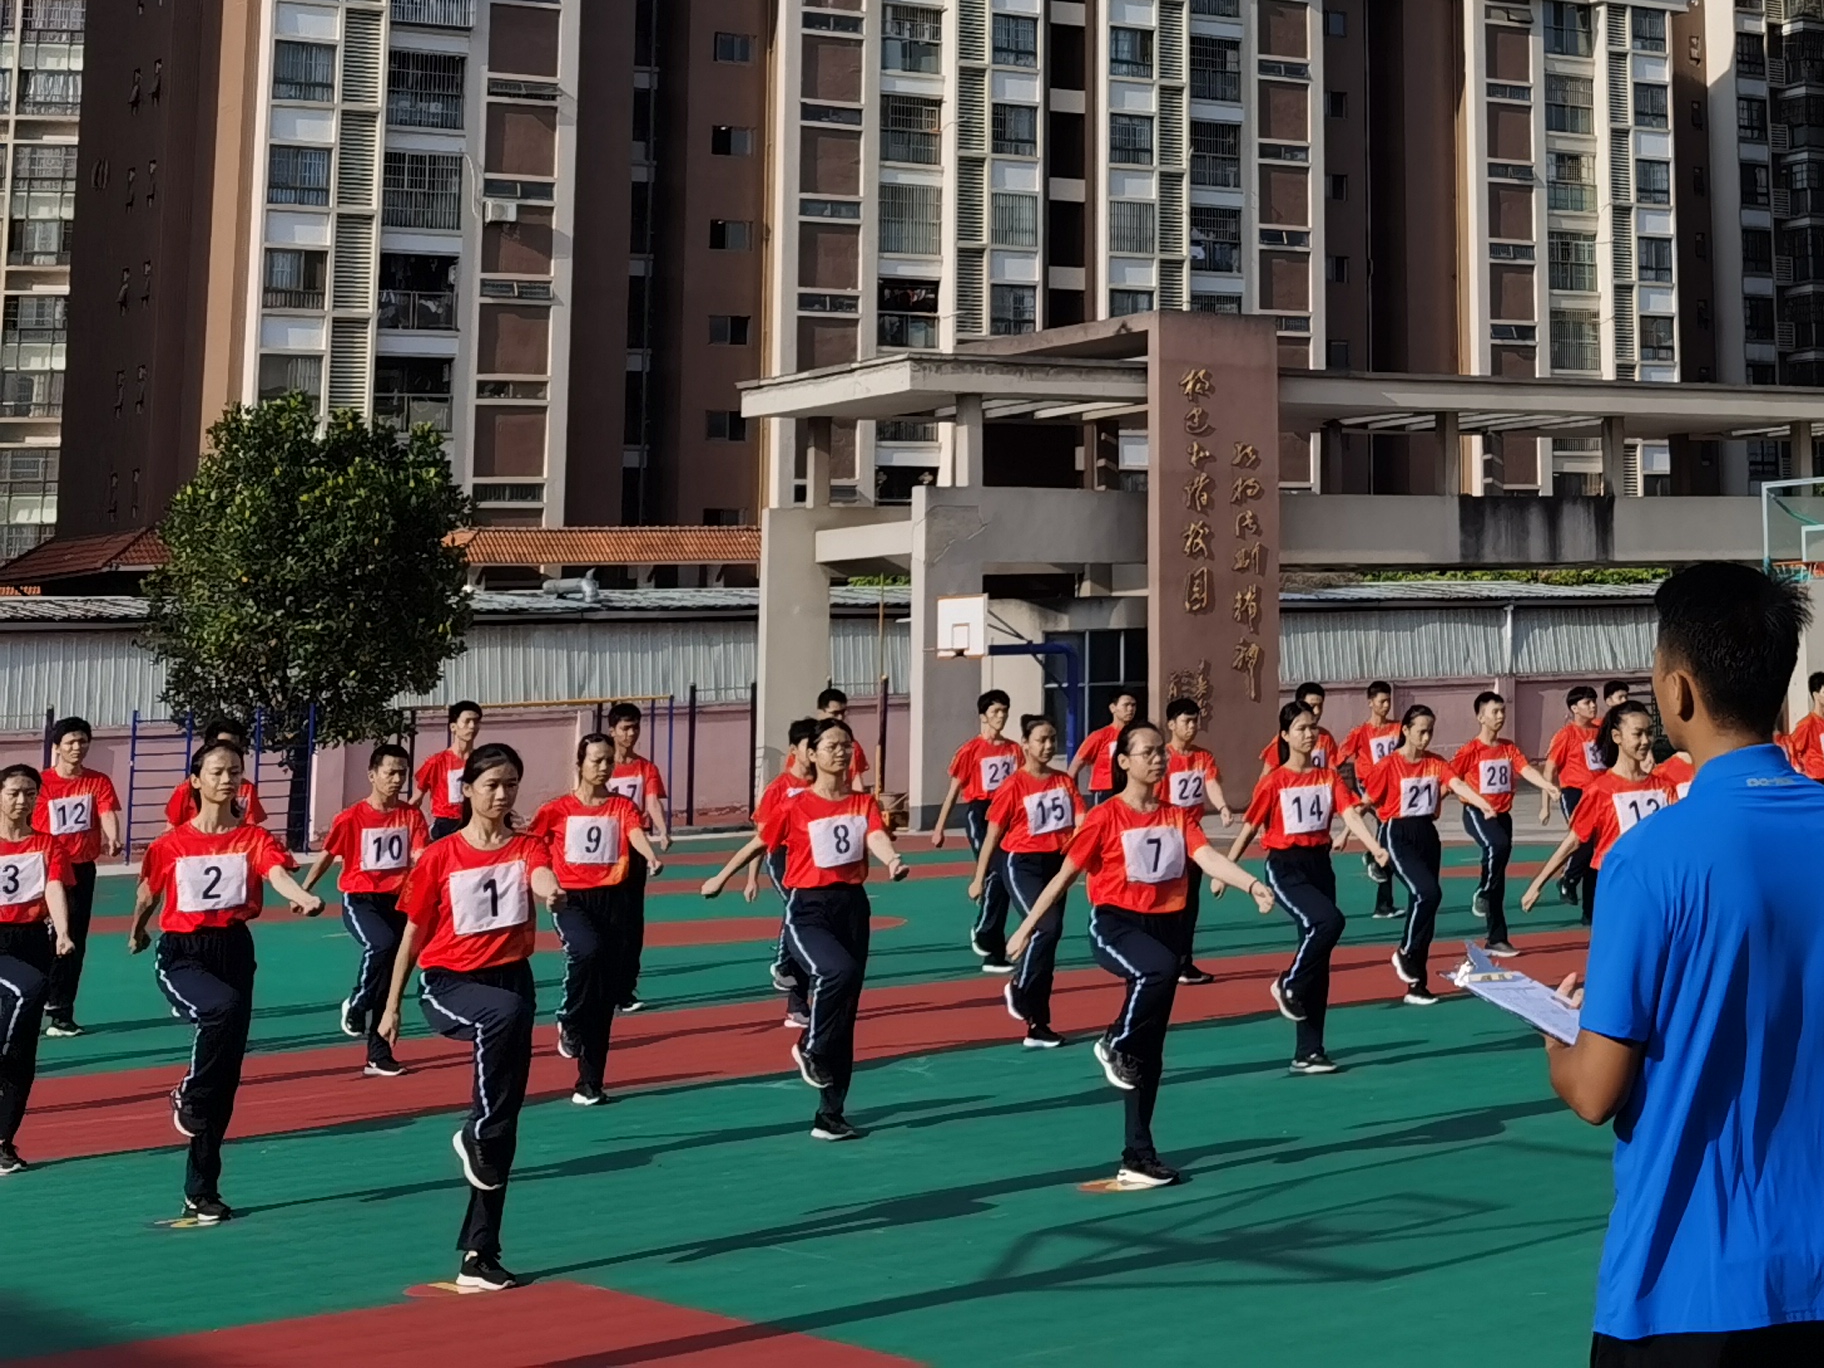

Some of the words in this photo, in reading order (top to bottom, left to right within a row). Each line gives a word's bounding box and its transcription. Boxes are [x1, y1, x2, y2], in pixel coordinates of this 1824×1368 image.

[988, 762, 1011, 783] 23
[1487, 765, 1508, 786] 28
[1178, 776, 1203, 800] 22
[1408, 784, 1433, 808] 21
[58, 803, 87, 826] 12
[1036, 796, 1065, 825] 15
[1292, 794, 1323, 823] 14
[373, 835, 402, 862] 10
[585, 826, 602, 853] 9
[833, 824, 851, 854] 8
[1147, 838, 1162, 872] 7
[3, 865, 20, 894] 3
[202, 866, 222, 899] 2
[483, 878, 499, 917] 1
